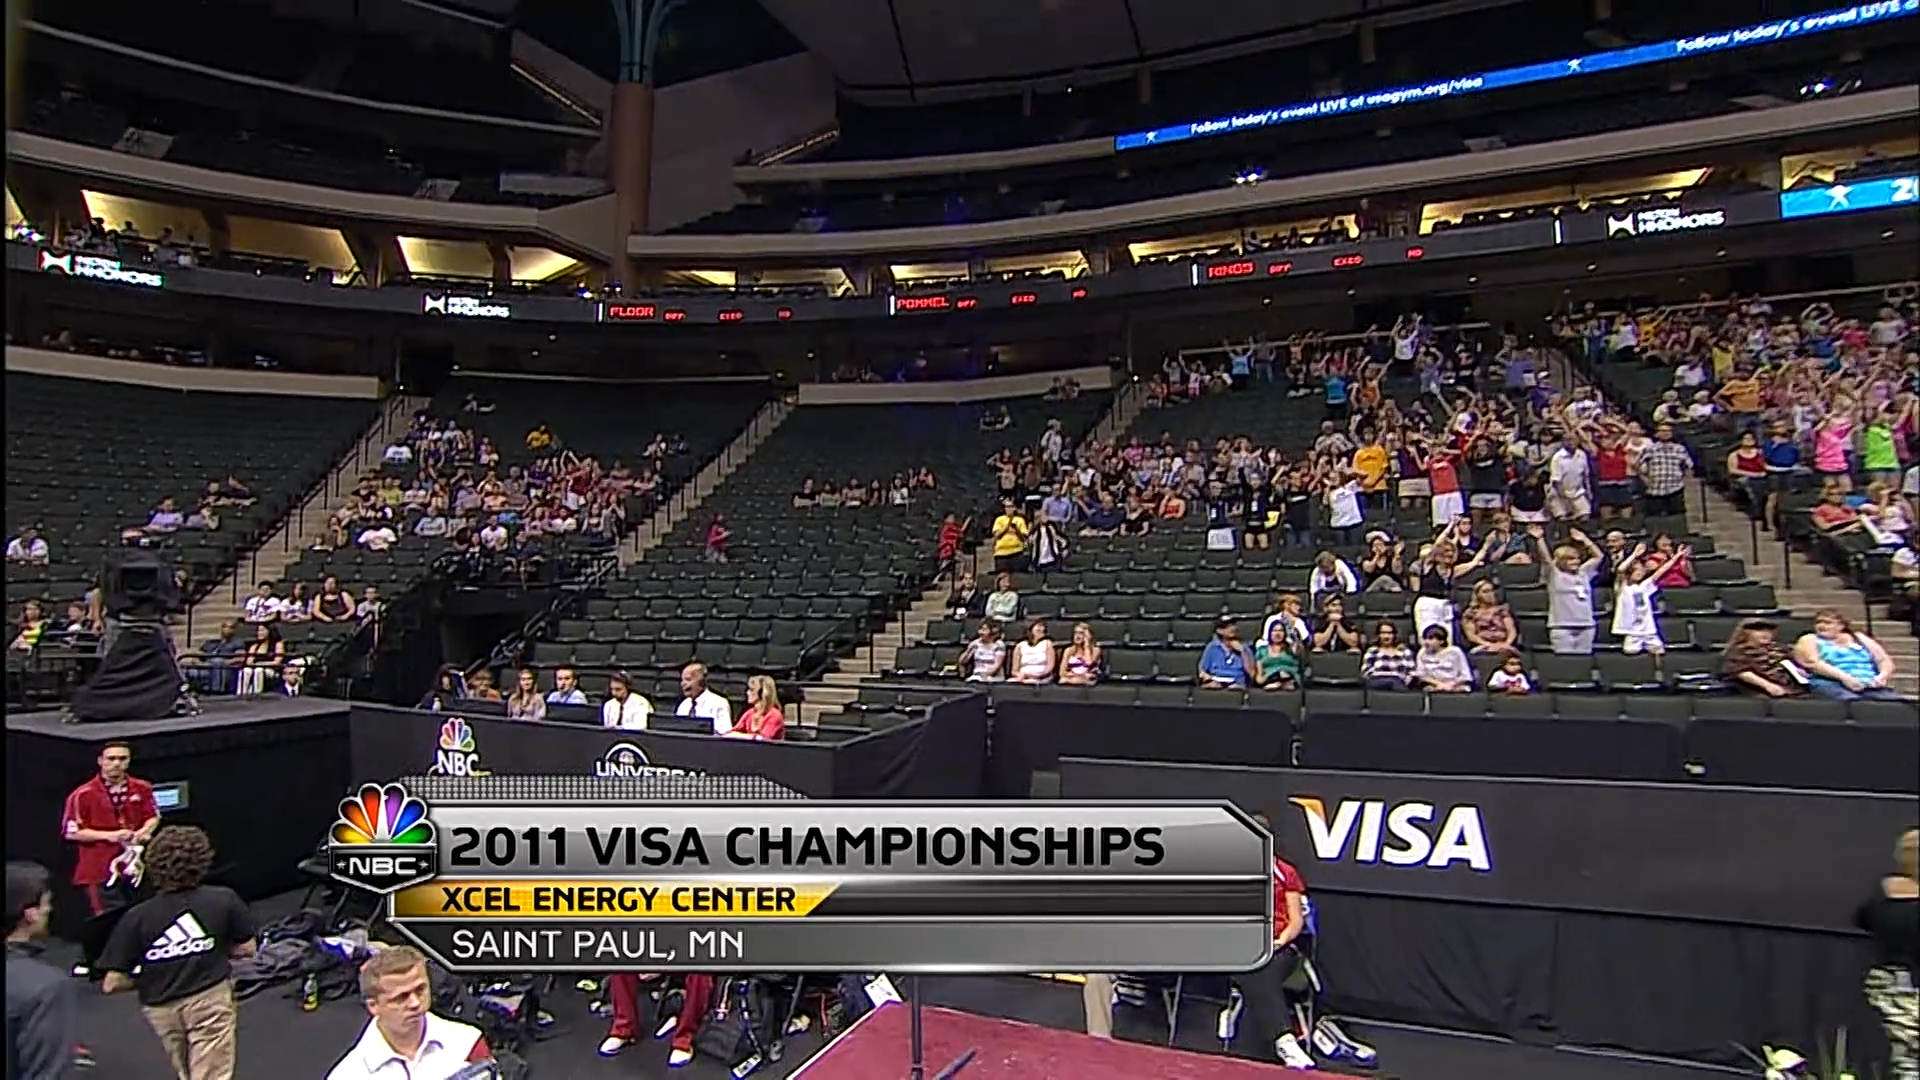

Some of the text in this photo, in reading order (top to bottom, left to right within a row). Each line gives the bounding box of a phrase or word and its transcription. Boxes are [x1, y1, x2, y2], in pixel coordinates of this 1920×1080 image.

[1677, 34, 1731, 52] Follow
[1860, 0, 1900, 18] LIVE
[1191, 77, 1483, 136] Follow today's event LIVE at usagym.org/visa
[1890, 177, 1919, 202] 2
[609, 305, 655, 319] FLOOR
[896, 296, 950, 310] POMMEL
[437, 749, 480, 776] NBC
[1289, 796, 1491, 871] VISA
[145, 937, 216, 961] adidas
